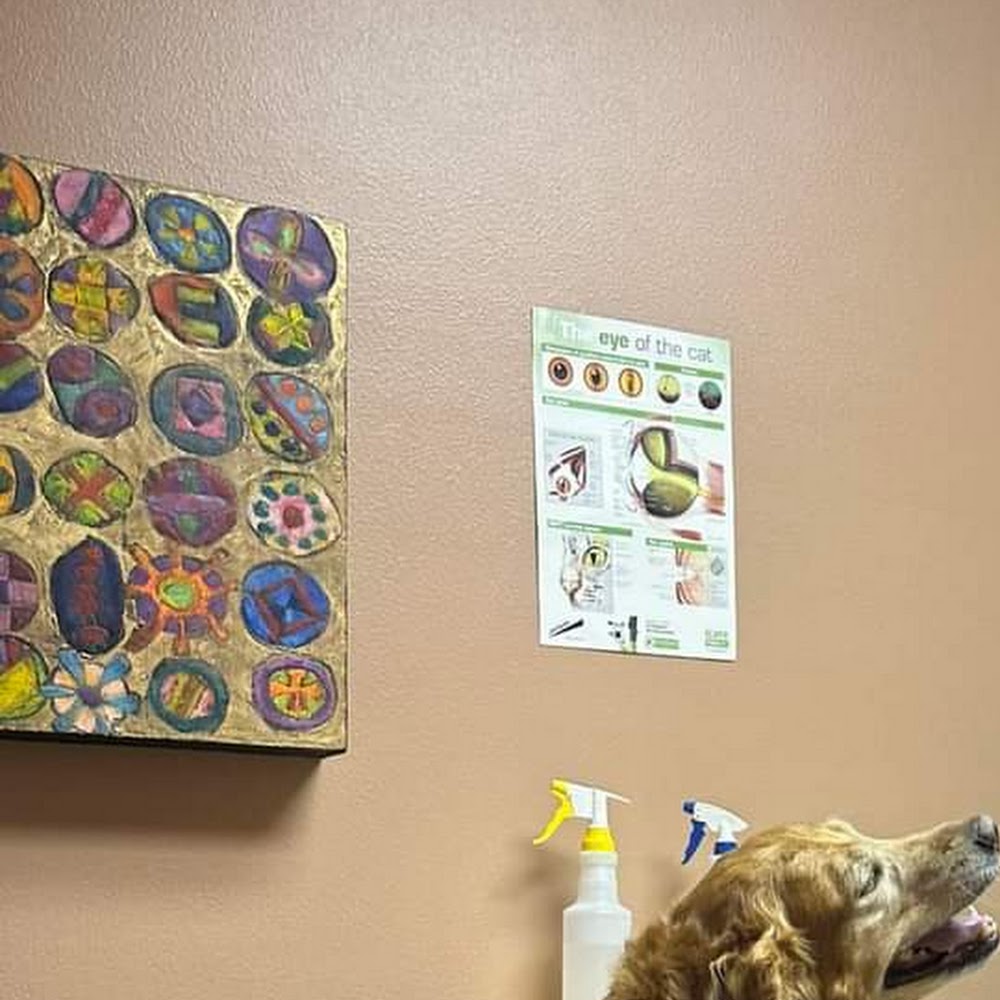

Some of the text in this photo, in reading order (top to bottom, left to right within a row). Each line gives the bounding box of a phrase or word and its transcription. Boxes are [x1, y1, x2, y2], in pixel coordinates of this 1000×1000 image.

[599, 331, 630, 351] eye
[634, 333, 652, 352] of
[656, 338, 683, 358] the
[687, 346, 714, 364] cat
